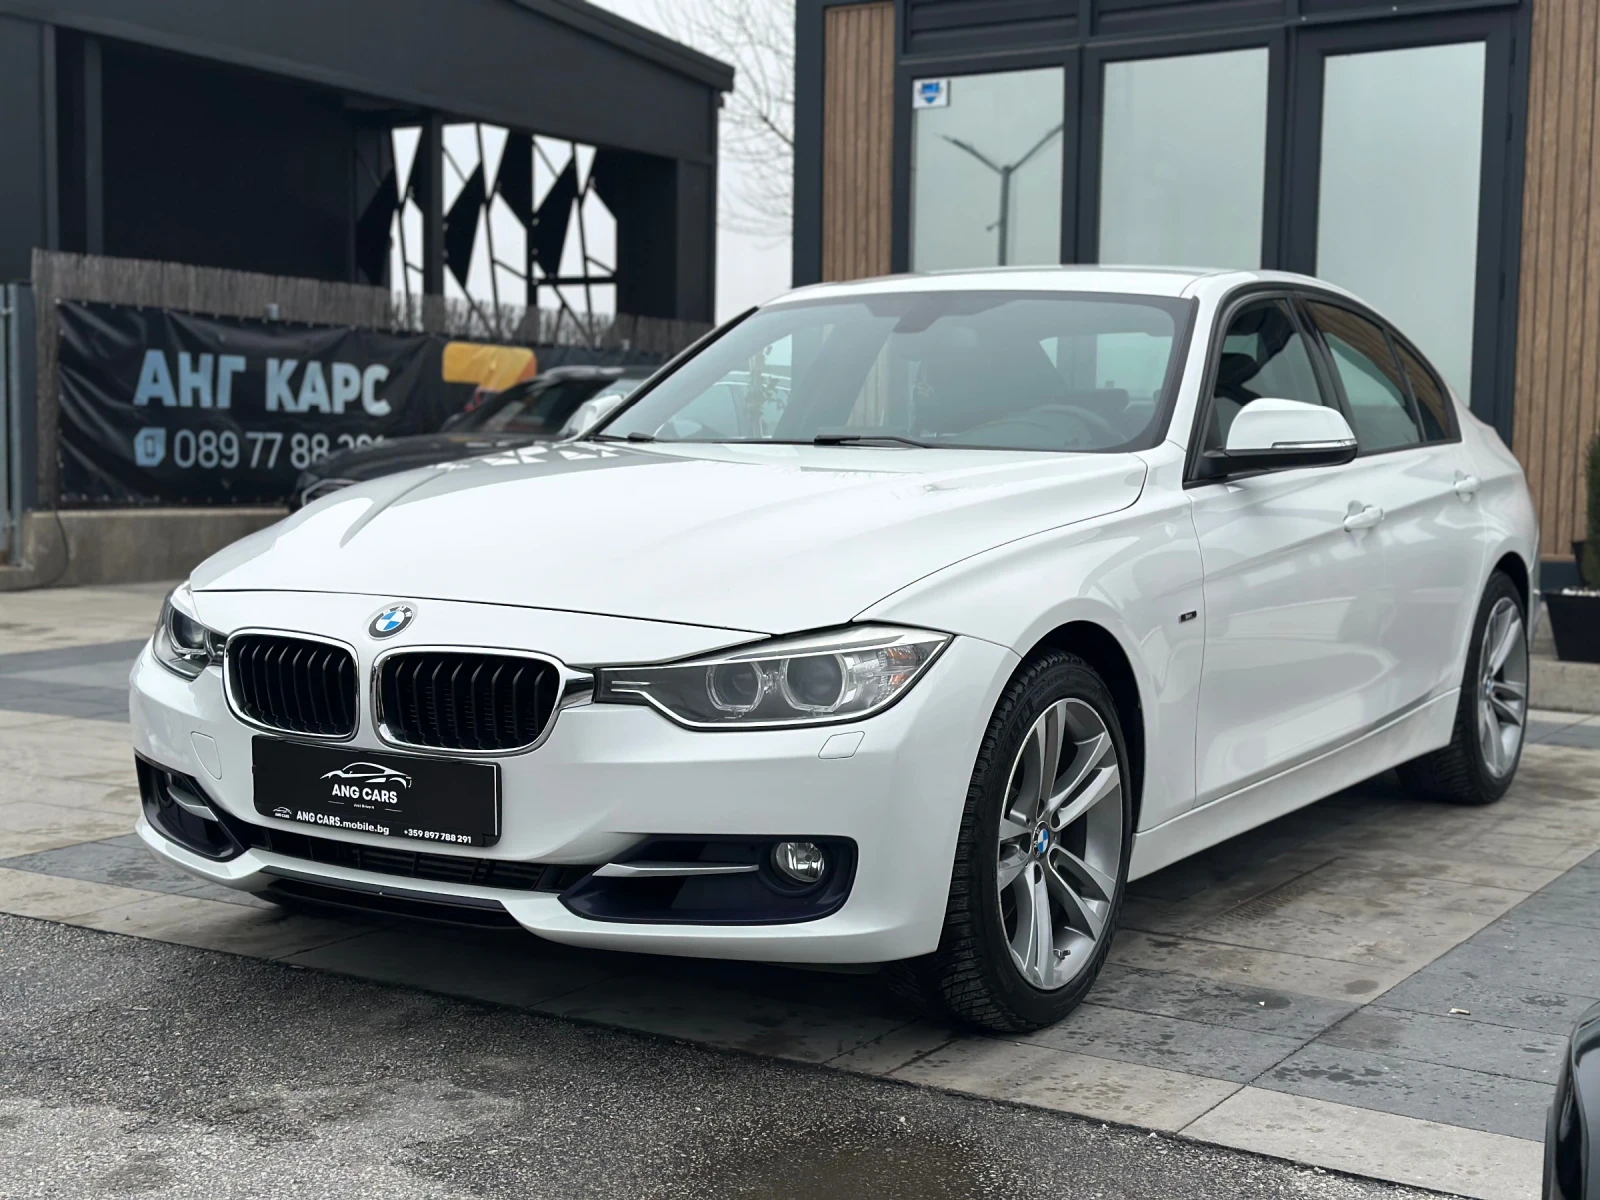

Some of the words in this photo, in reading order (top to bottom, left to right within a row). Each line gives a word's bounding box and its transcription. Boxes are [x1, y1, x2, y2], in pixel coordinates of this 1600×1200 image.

[133, 349, 247, 410] АНГ
[265, 357, 392, 416] КАРС
[173, 429, 240, 469] 089
[245, 430, 284, 470] 77
[290, 432, 330, 470] 88
[331, 783, 360, 799] ANG
[362, 787, 398, 804] CARS
[296, 810, 315, 823] ANG
[316, 814, 390, 836] CARS.mobile.bg
[403, 828, 424, 838] +359
[424, 830, 440, 840] 897
[440, 832, 456, 842] 788
[457, 834, 472, 844] 291
